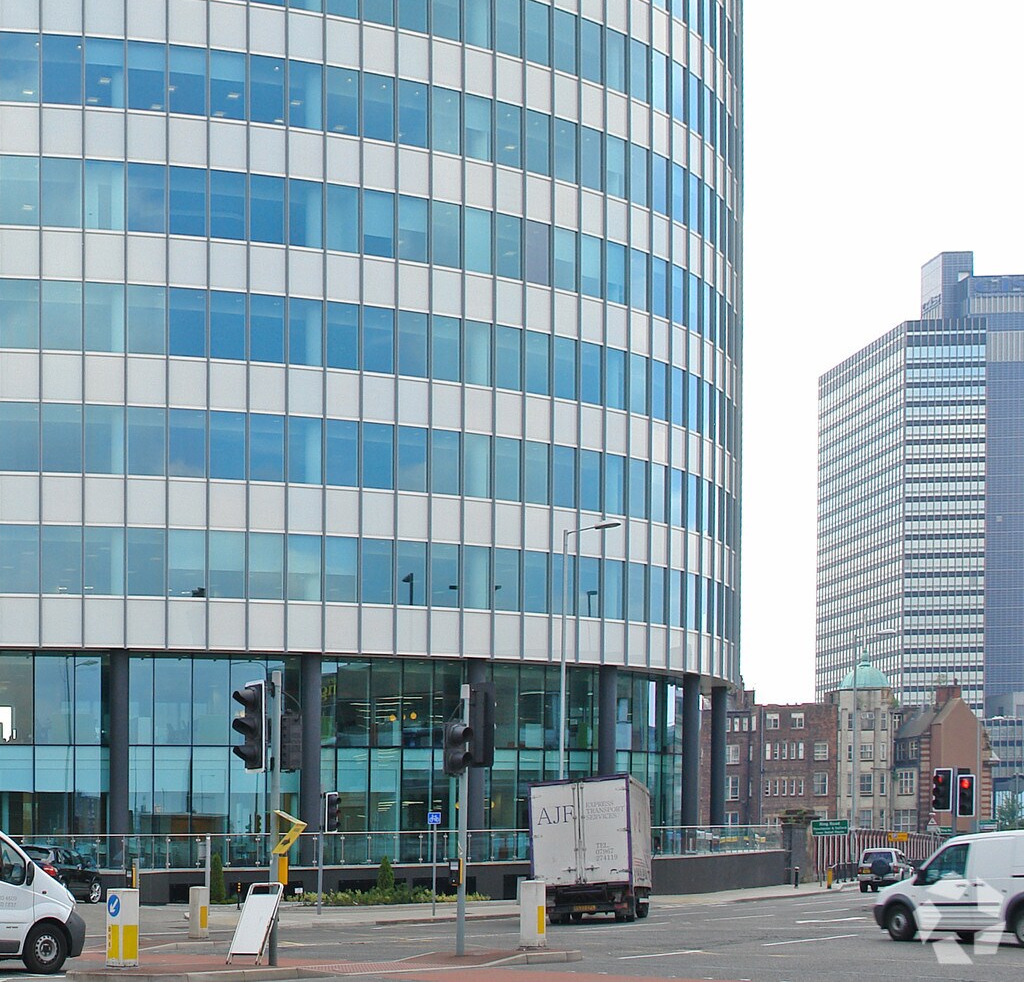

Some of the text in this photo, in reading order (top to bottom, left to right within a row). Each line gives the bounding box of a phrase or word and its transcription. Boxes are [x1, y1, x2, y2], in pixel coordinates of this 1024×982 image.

[585, 801, 615, 809] EXPRESS
[586, 806, 625, 815] TRANSPORT
[537, 804, 575, 826] AJF
[586, 813, 617, 821] SERVICES
